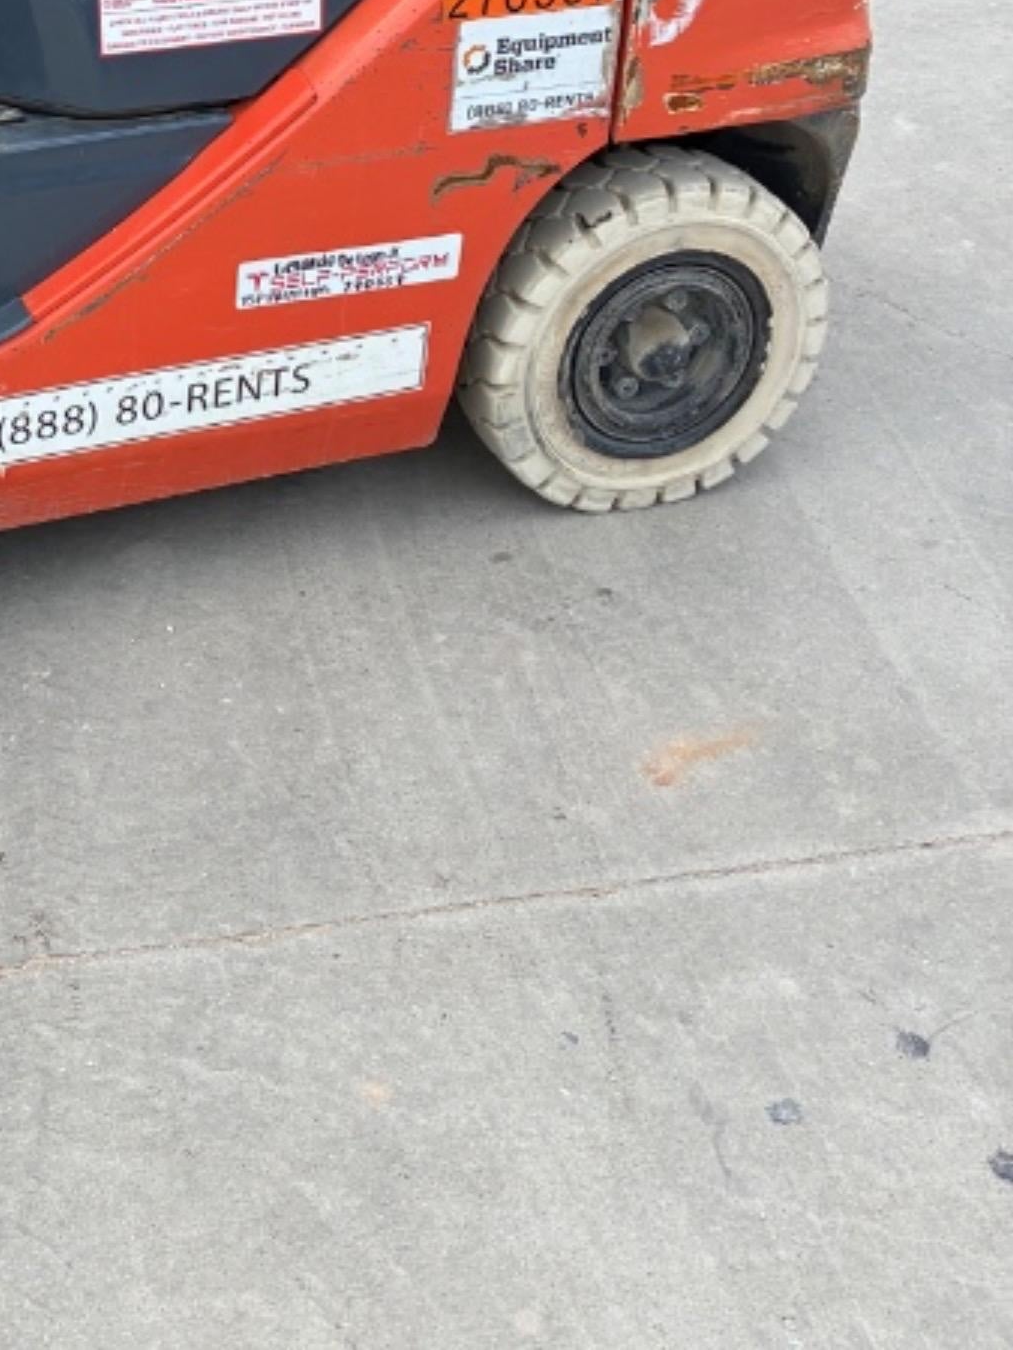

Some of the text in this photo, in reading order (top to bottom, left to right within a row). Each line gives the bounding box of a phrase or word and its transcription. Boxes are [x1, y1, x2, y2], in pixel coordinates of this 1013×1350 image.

[495, 27, 612, 57] Equipment
[493, 56, 556, 76] Share
[114, 364, 312, 426] 80-RENTS
